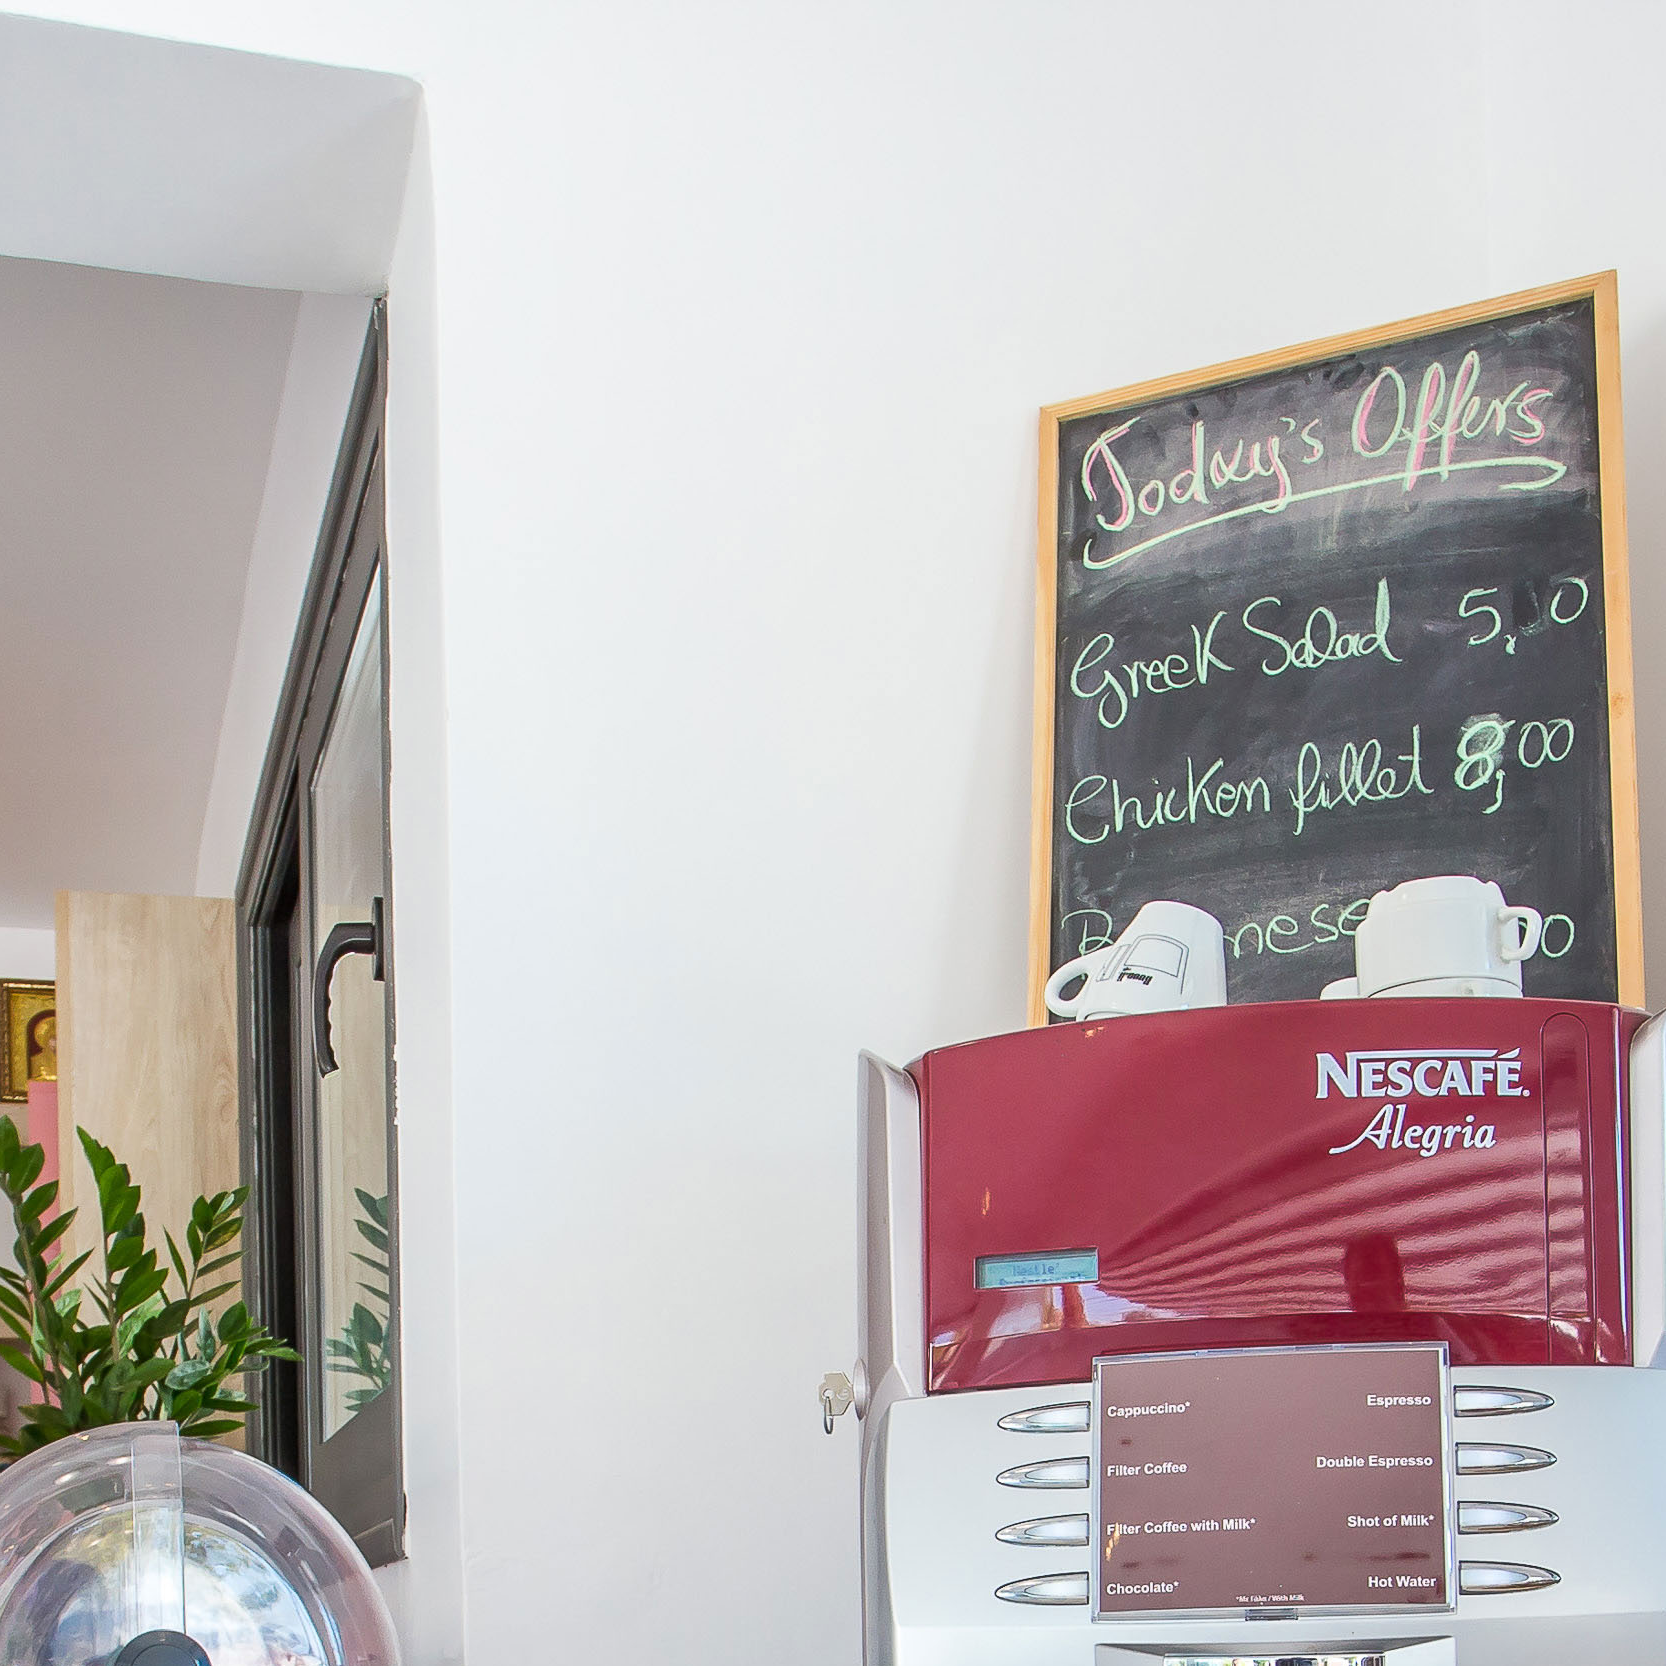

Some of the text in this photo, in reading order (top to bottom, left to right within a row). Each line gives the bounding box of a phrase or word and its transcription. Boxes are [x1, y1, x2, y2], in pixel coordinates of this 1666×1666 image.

[1082, 350, 1554, 532] Today's Offers
[1242, 576, 1402, 676] Salad
[1289, 724, 1433, 836] fillet
[1454, 718, 1575, 814] 8,00
[1315, 1047, 1524, 1099] NESCAFÉ
[1329, 1103, 1497, 1157] Alegria
[1367, 1394, 1432, 1408] Espresso
[1107, 1462, 1188, 1477] Filter Coffee
[1316, 1455, 1433, 1469] Double Espresso
[1107, 1523, 1141, 1536] Flter
[1144, 1520, 1187, 1534] Coffee
[1190, 1519, 1219, 1532] with
[1347, 1515, 1380, 1528] Shot
[1383, 1515, 1398, 1527] of
[1368, 1576, 1436, 1588] Hot Water
